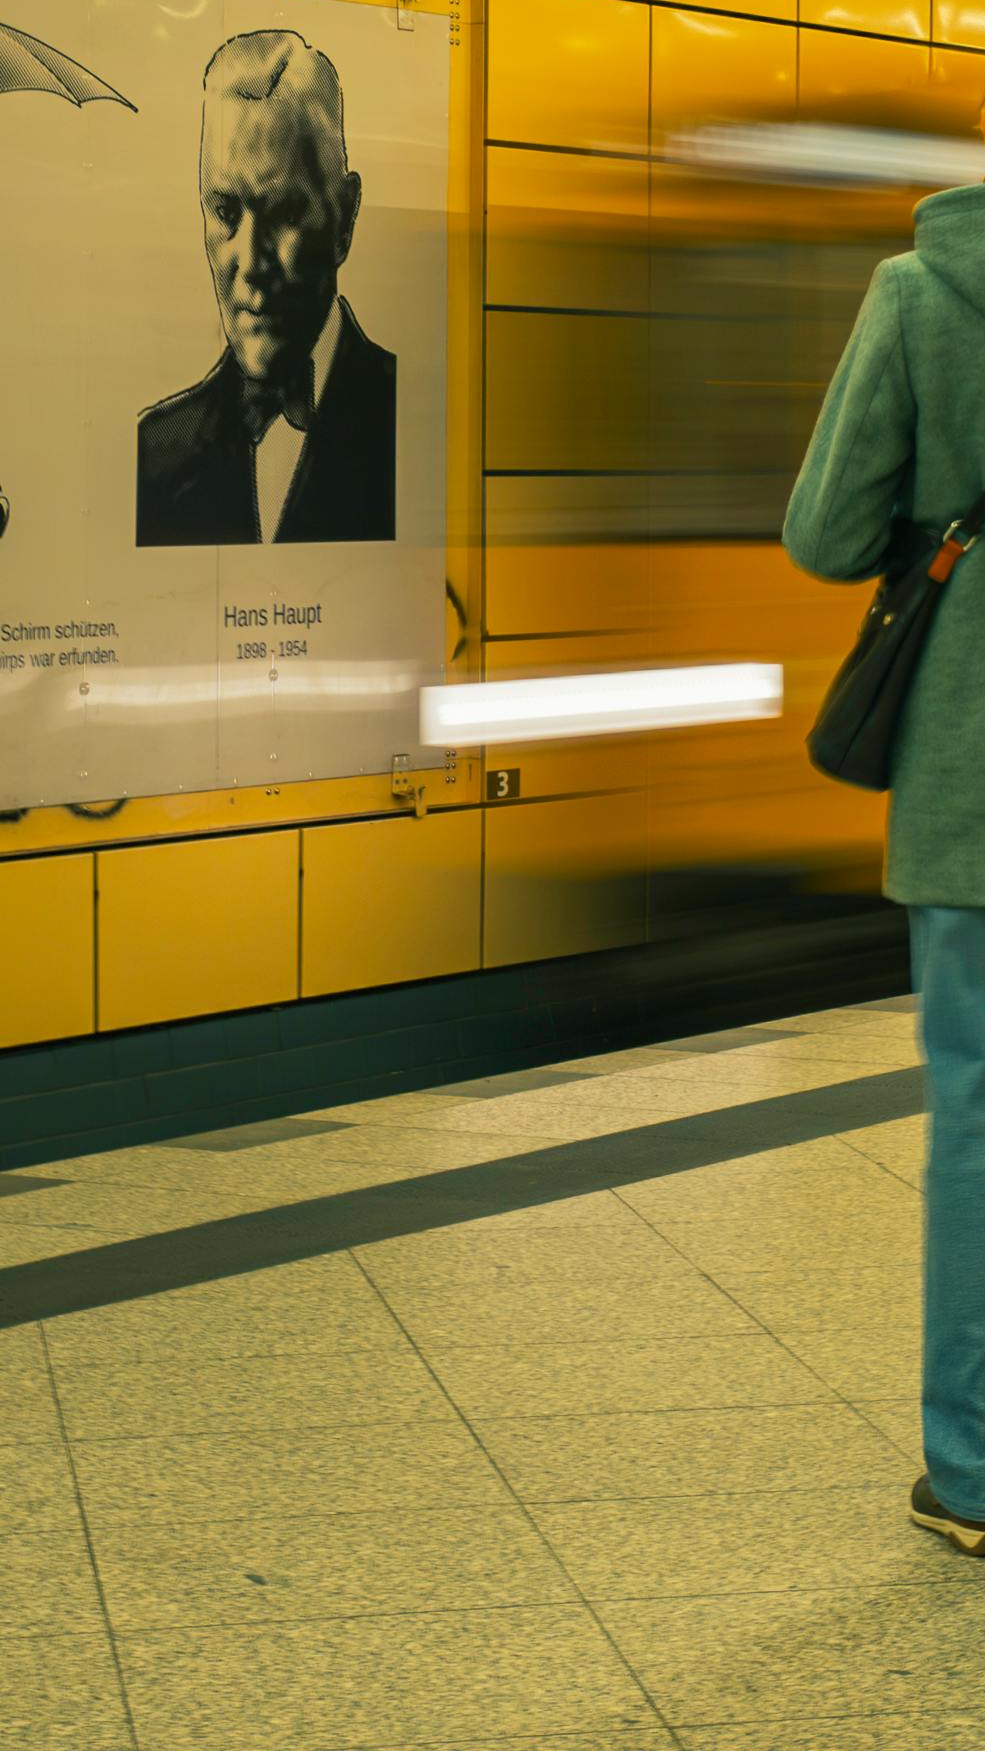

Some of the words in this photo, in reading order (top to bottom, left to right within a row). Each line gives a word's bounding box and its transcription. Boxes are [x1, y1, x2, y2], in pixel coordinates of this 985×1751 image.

[224, 606, 268, 627] Hans
[273, 603, 322, 629] Haupt
[0, 622, 51, 642] Schirm
[55, 620, 119, 639] schützen,
[30, 652, 55, 667] war
[60, 647, 119, 666] erfunden.
[237, 642, 267, 660] 1898
[279, 640, 307, 657] 1954
[497, 771, 508, 797] 3
